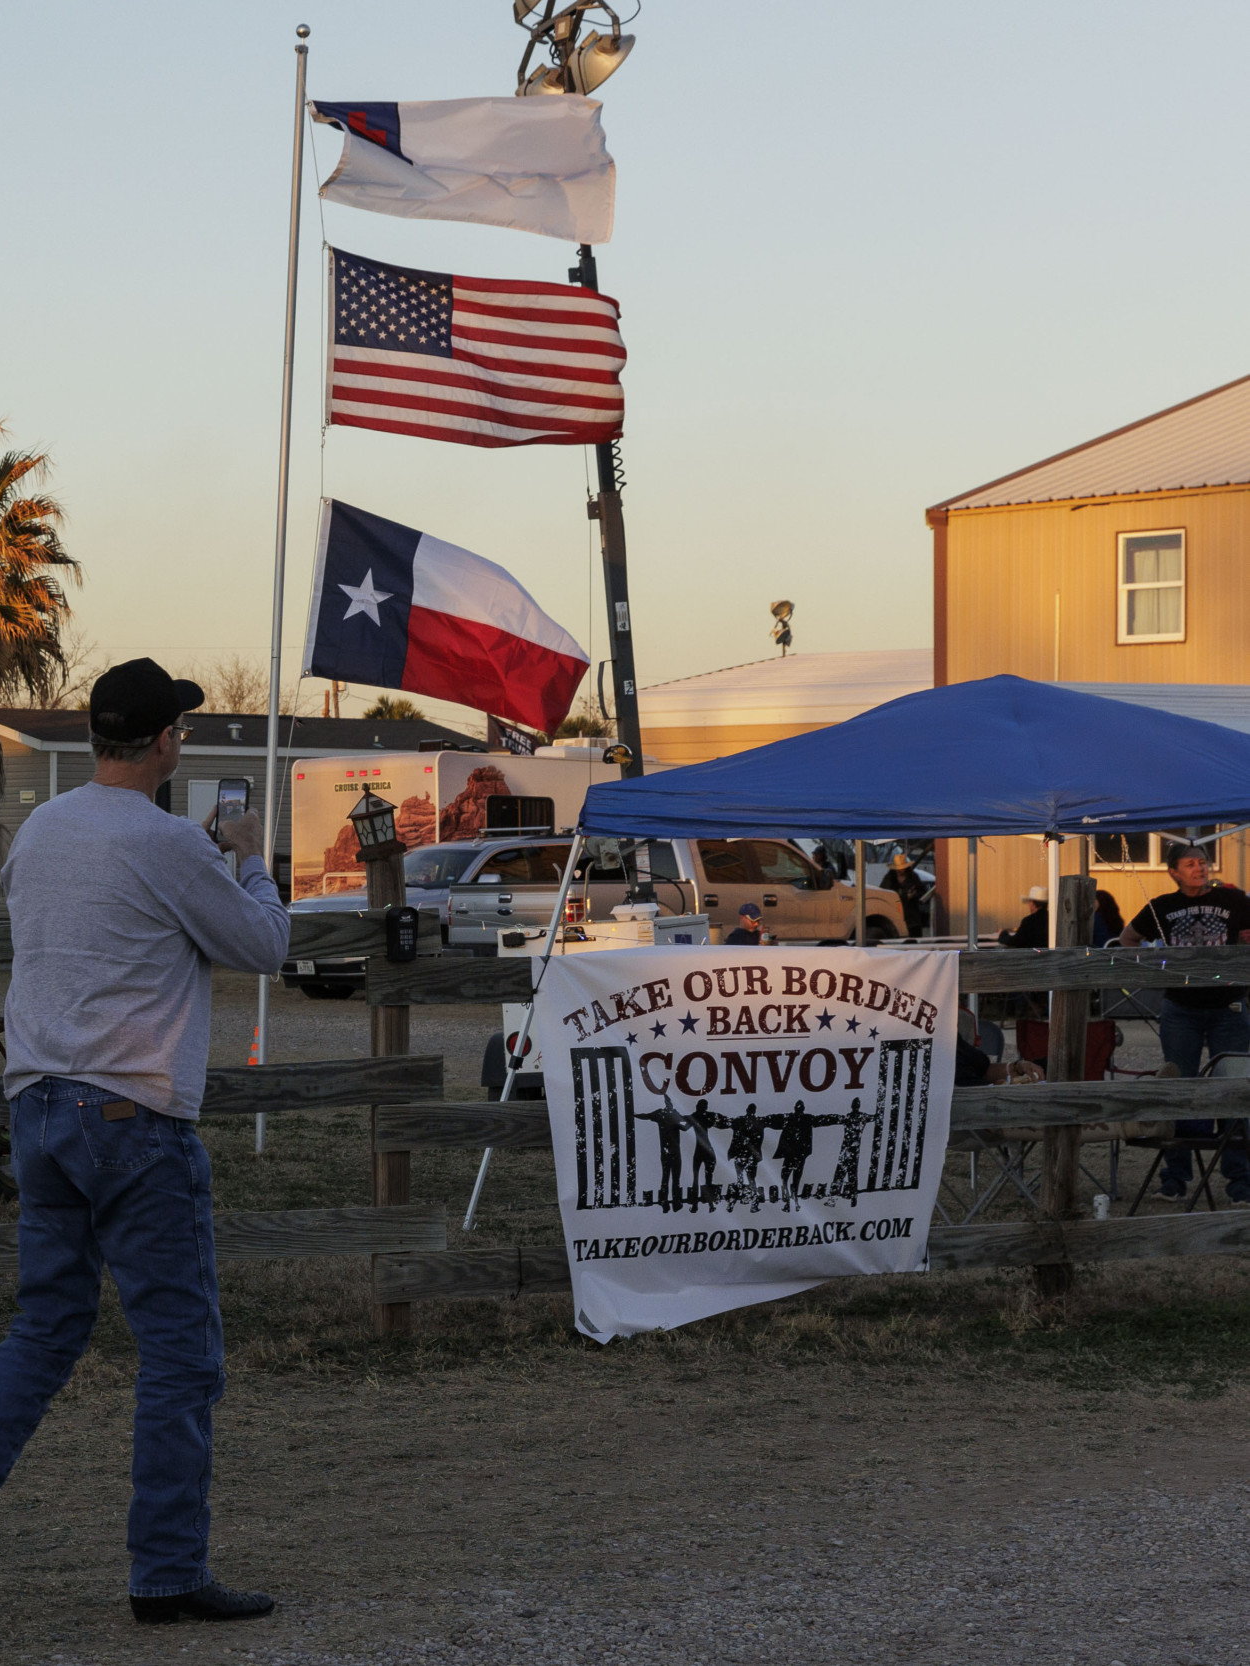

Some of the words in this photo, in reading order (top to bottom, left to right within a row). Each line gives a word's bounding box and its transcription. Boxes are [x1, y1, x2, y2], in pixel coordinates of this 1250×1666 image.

[505, 728, 532, 750] FREE
[334, 783, 359, 792] CRUISE
[361, 782, 392, 791] ERICA
[563, 977, 673, 1043] TAKE
[683, 965, 773, 1002] OUR
[781, 966, 939, 1034] BORDER
[706, 1004, 812, 1036] BACK
[638, 1047, 875, 1097] CONVOY
[573, 1217, 914, 1263] TAKEOURBORDERBACK.COM
